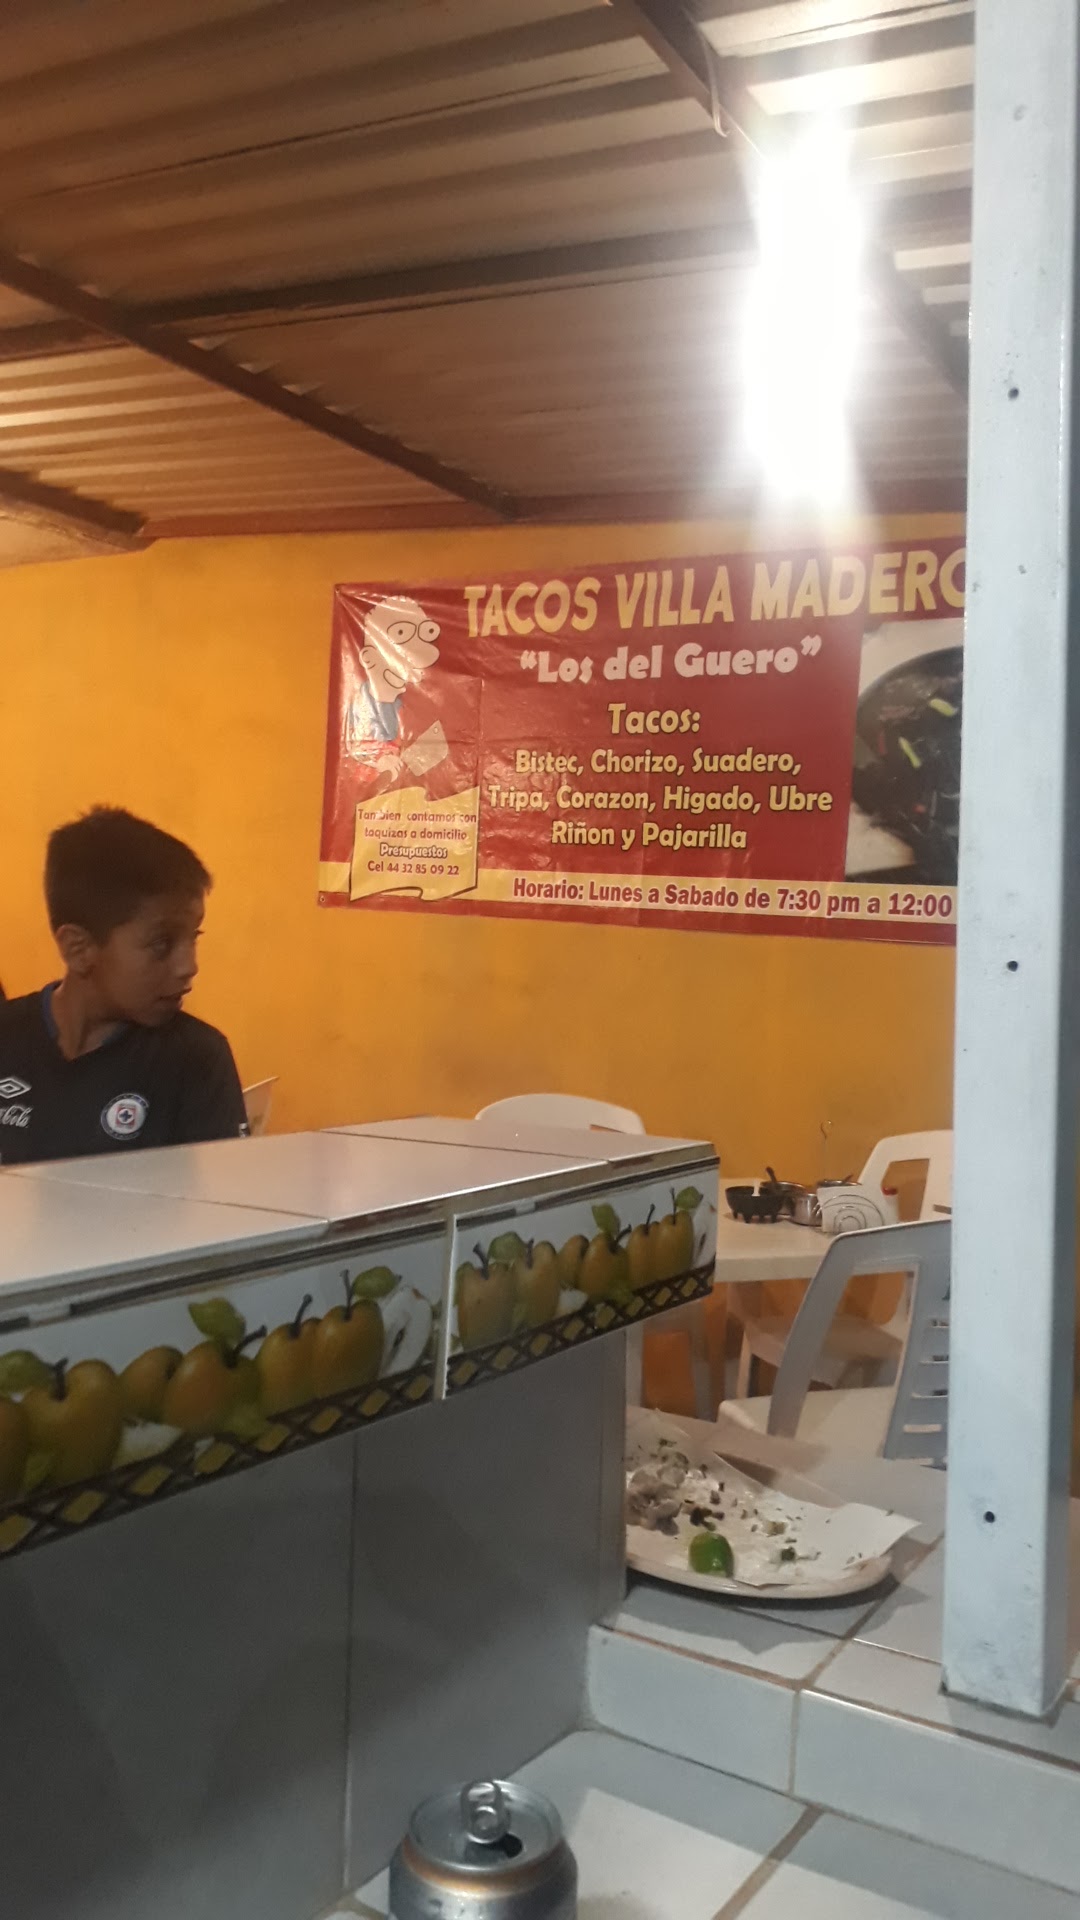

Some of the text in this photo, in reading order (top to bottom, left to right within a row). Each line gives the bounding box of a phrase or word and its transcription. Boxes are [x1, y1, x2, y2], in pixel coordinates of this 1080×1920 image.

[464, 548, 966, 637] TACOS VILLA MADERO
[603, 646, 664, 681] del
[607, 702, 701, 734] Tacos:
[515, 746, 801, 776] Bistec, Chorizo, Suadero,
[488, 784, 833, 814] Tripa, Corazon, Higado, Ubre
[365, 827, 468, 840] taquizas a domicilio
[551, 820, 747, 851] Riñon y Pajarilla
[380, 842, 448, 859] Presupuestos
[368, 860, 459, 876] Cel 44 32 85 09 22
[513, 877, 952, 918] Horario: Lunes a Sabado de 7:30 pm a 12:00
